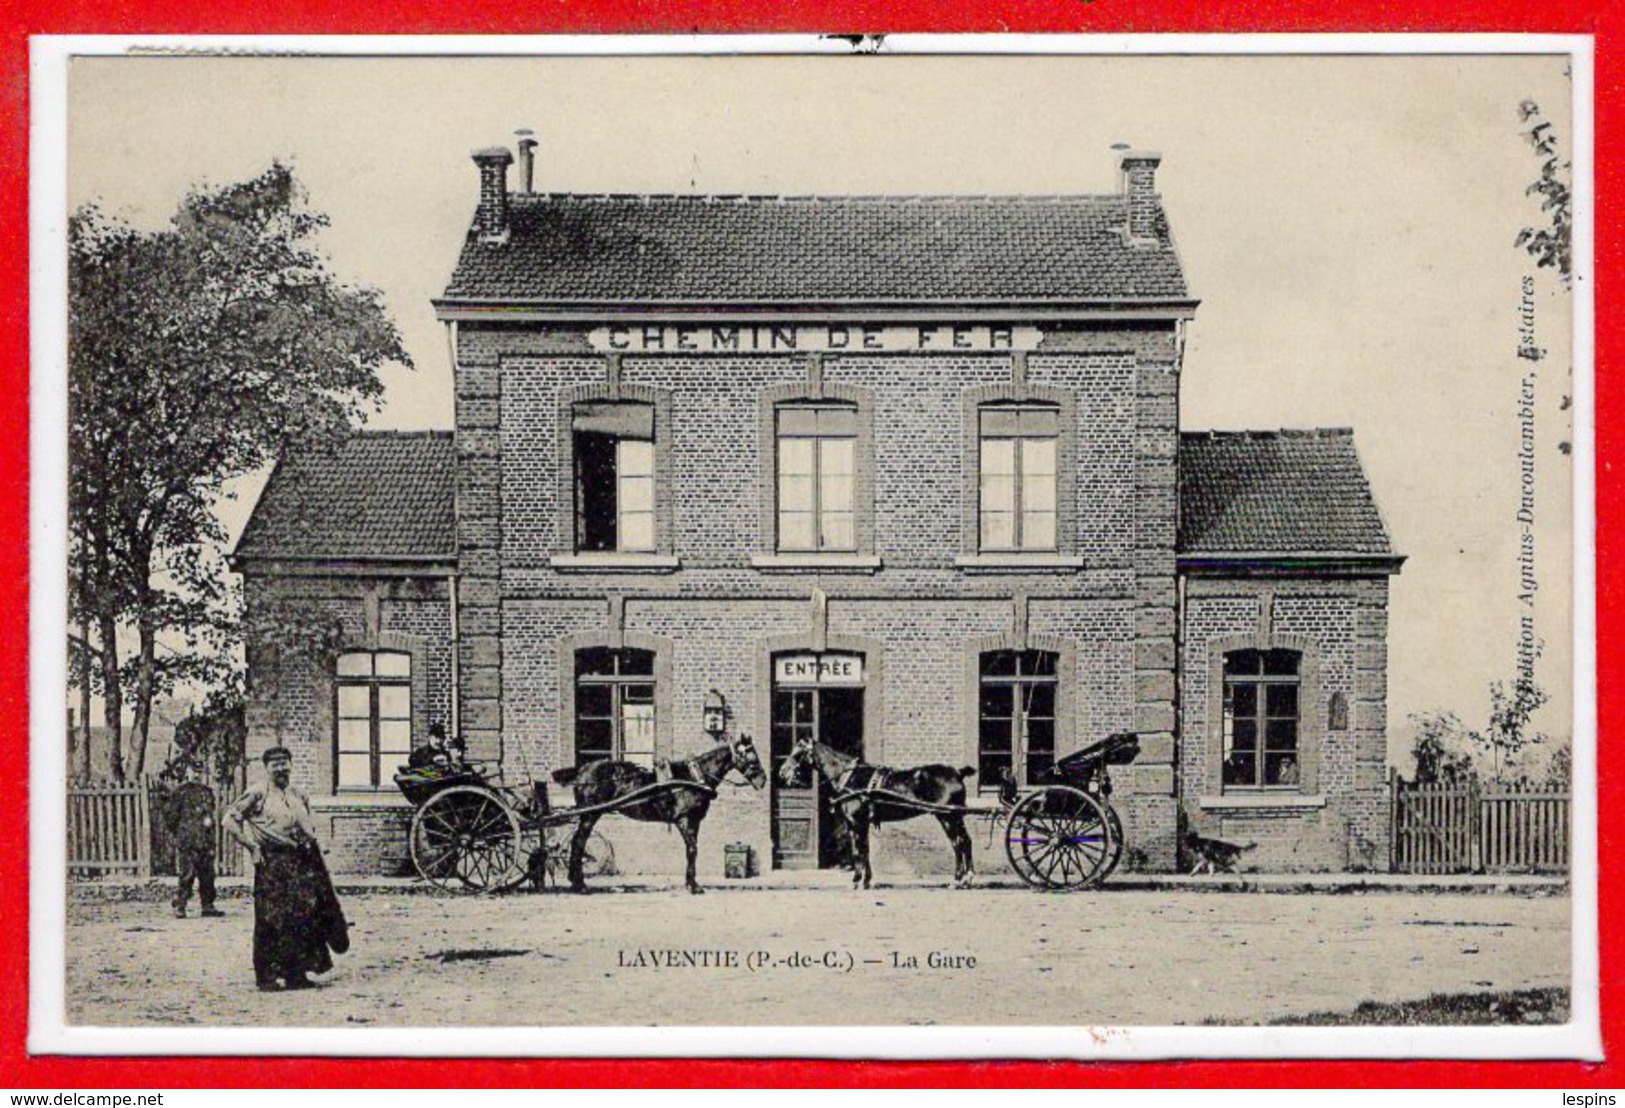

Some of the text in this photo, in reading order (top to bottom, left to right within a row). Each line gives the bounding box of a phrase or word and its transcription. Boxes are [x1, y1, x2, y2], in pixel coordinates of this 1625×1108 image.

[608, 326, 1013, 350] CHEMIN DE FER
[784, 660, 852, 676] ENTRÉE
